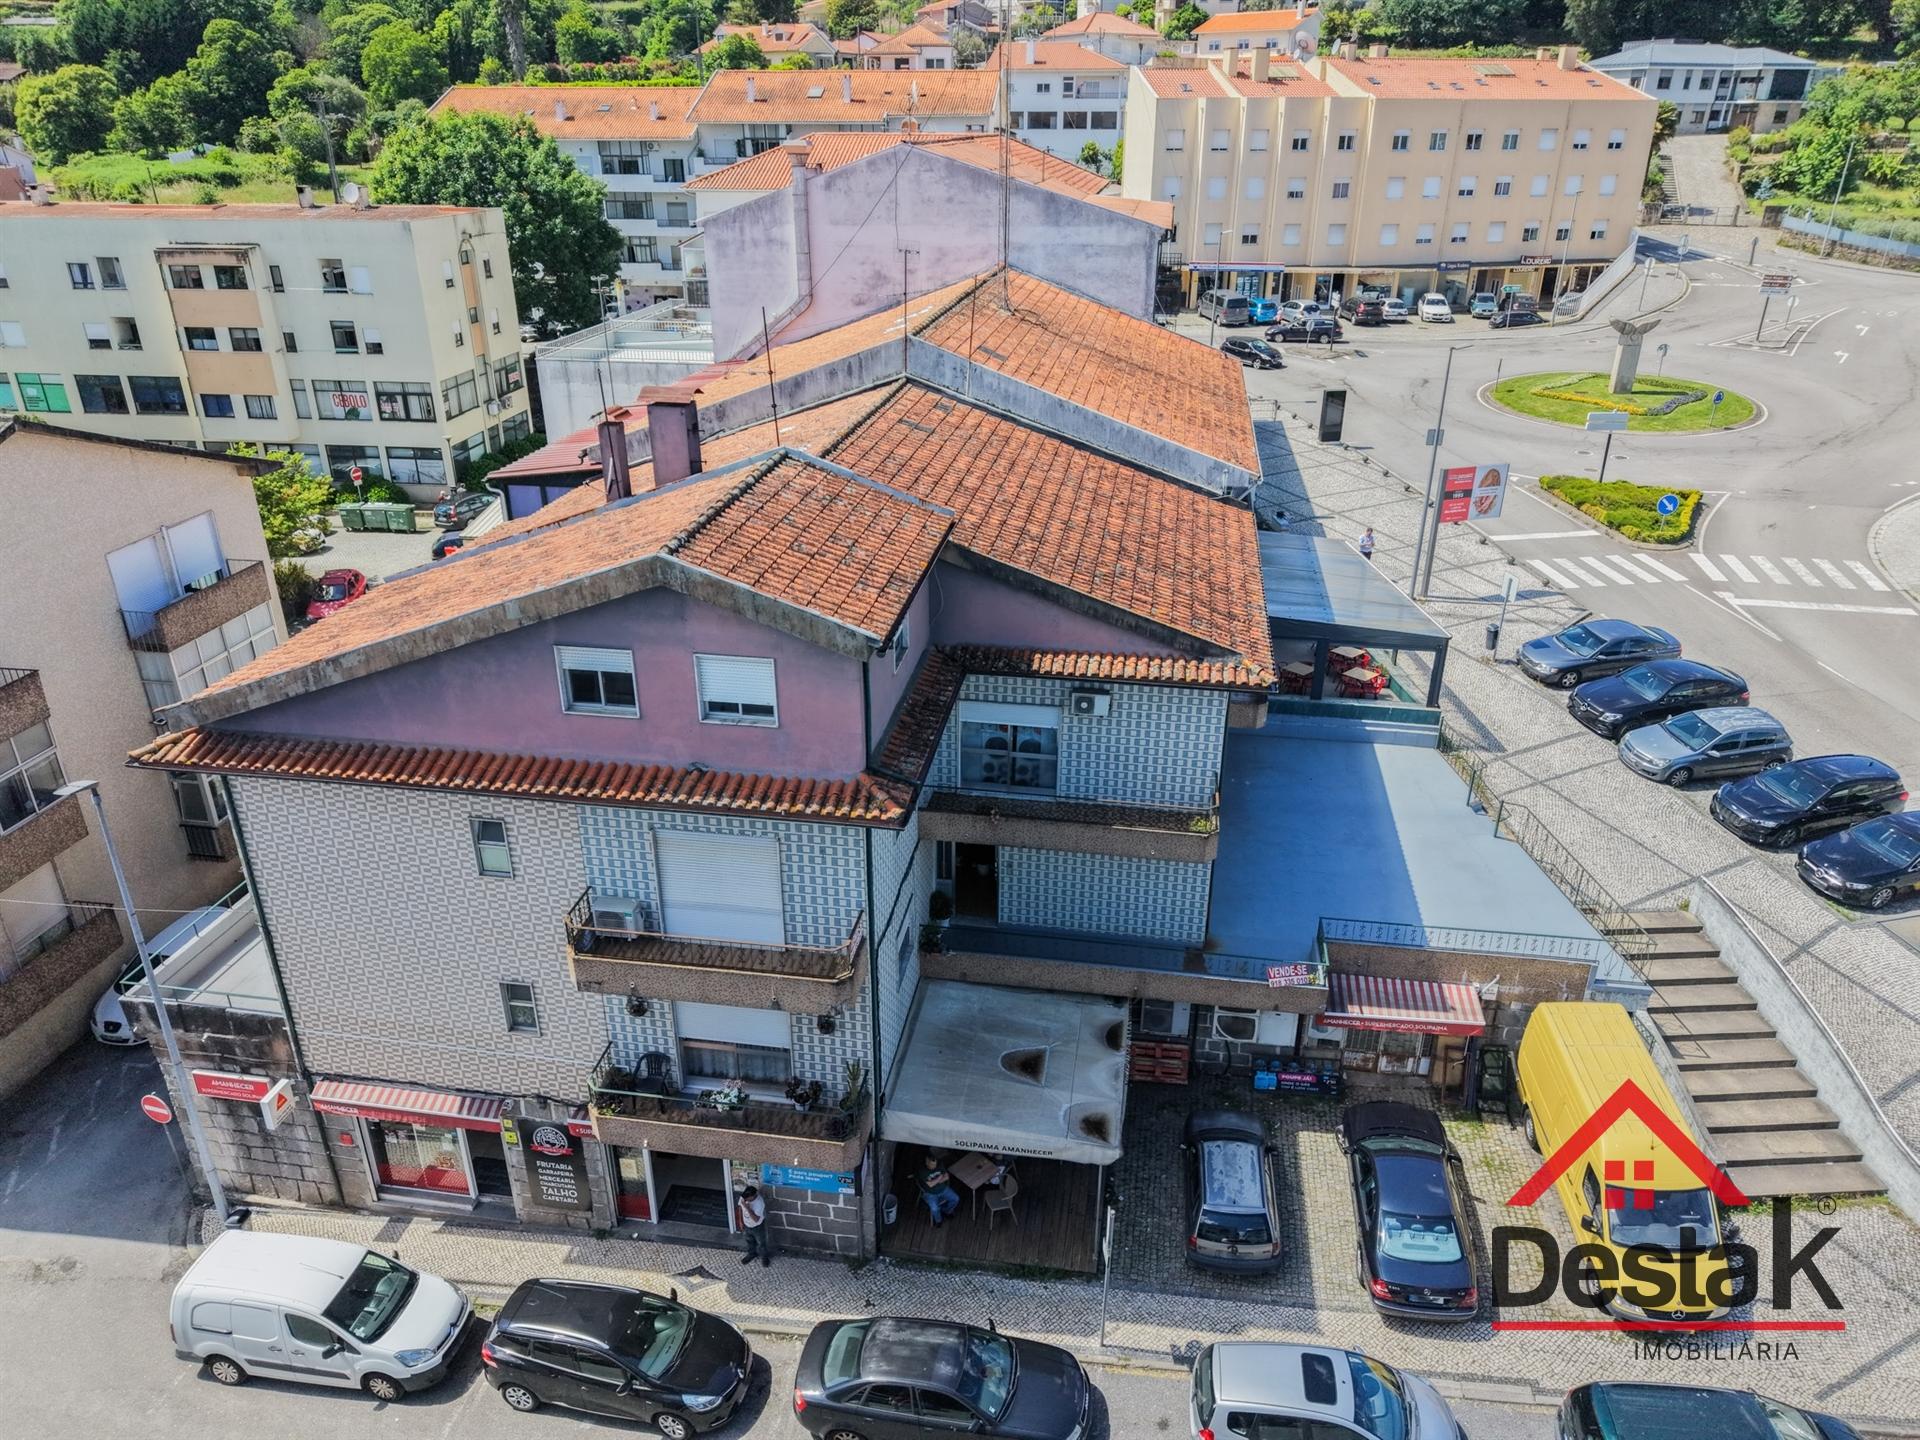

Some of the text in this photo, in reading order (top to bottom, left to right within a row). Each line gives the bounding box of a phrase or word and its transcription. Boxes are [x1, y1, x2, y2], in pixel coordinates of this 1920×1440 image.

[332, 393, 367, 408] CEBOLO
[1268, 965, 1308, 979] VENDE-SE
[1365, 1021, 1414, 1030] SUPERMERCADO
[211, 1079, 254, 1091] AMANHECER
[954, 1139, 1053, 1156] SOLIPAIMA AMANHECER
[536, 1160, 574, 1171] FRUTARIA
[538, 1174, 576, 1184] MERCEARIA
[541, 1186, 578, 1198] TALHO
[542, 1194, 579, 1204] CAFETARIA
